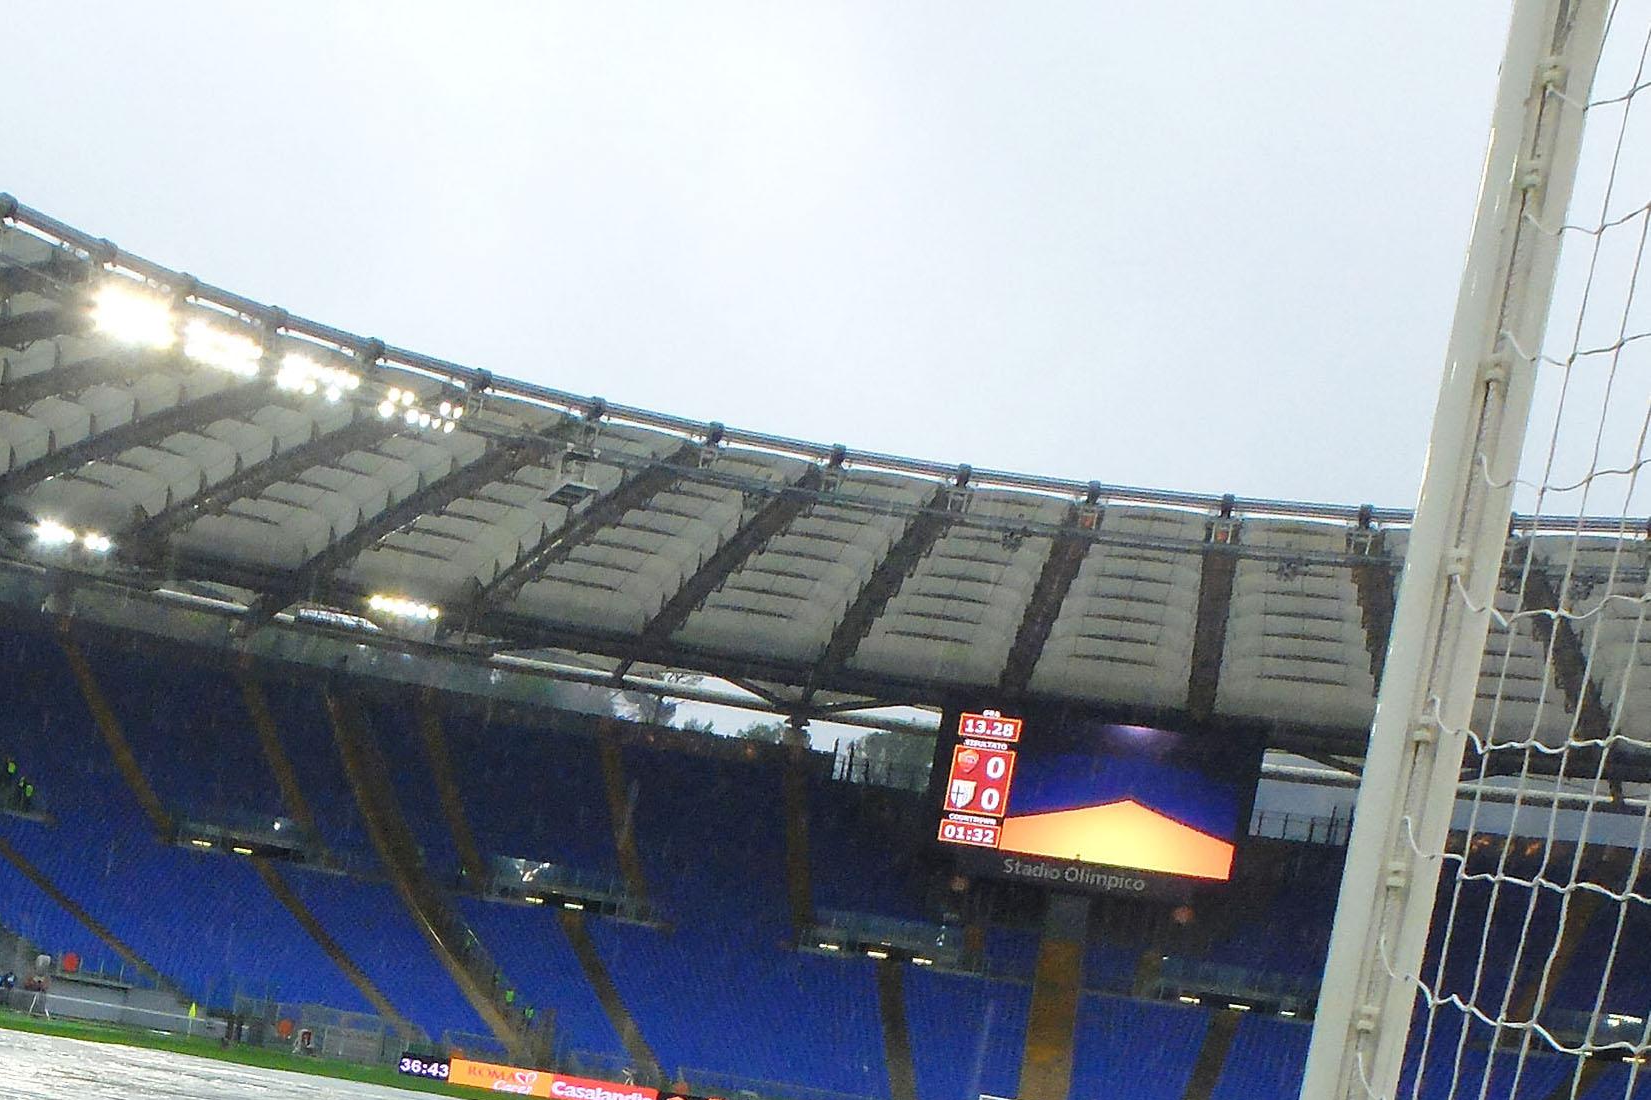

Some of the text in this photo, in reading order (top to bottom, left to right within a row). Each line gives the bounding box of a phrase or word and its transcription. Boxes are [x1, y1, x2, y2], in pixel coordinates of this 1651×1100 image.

[964, 719, 1015, 738] 13.28
[986, 756, 1006, 779] 0
[980, 787, 1000, 811] 0
[944, 824, 995, 843] 01:32
[1003, 858, 1146, 891] Stadio Olimpico
[399, 1058, 449, 1077] 36:43
[467, 1065, 517, 1082] ROMA
